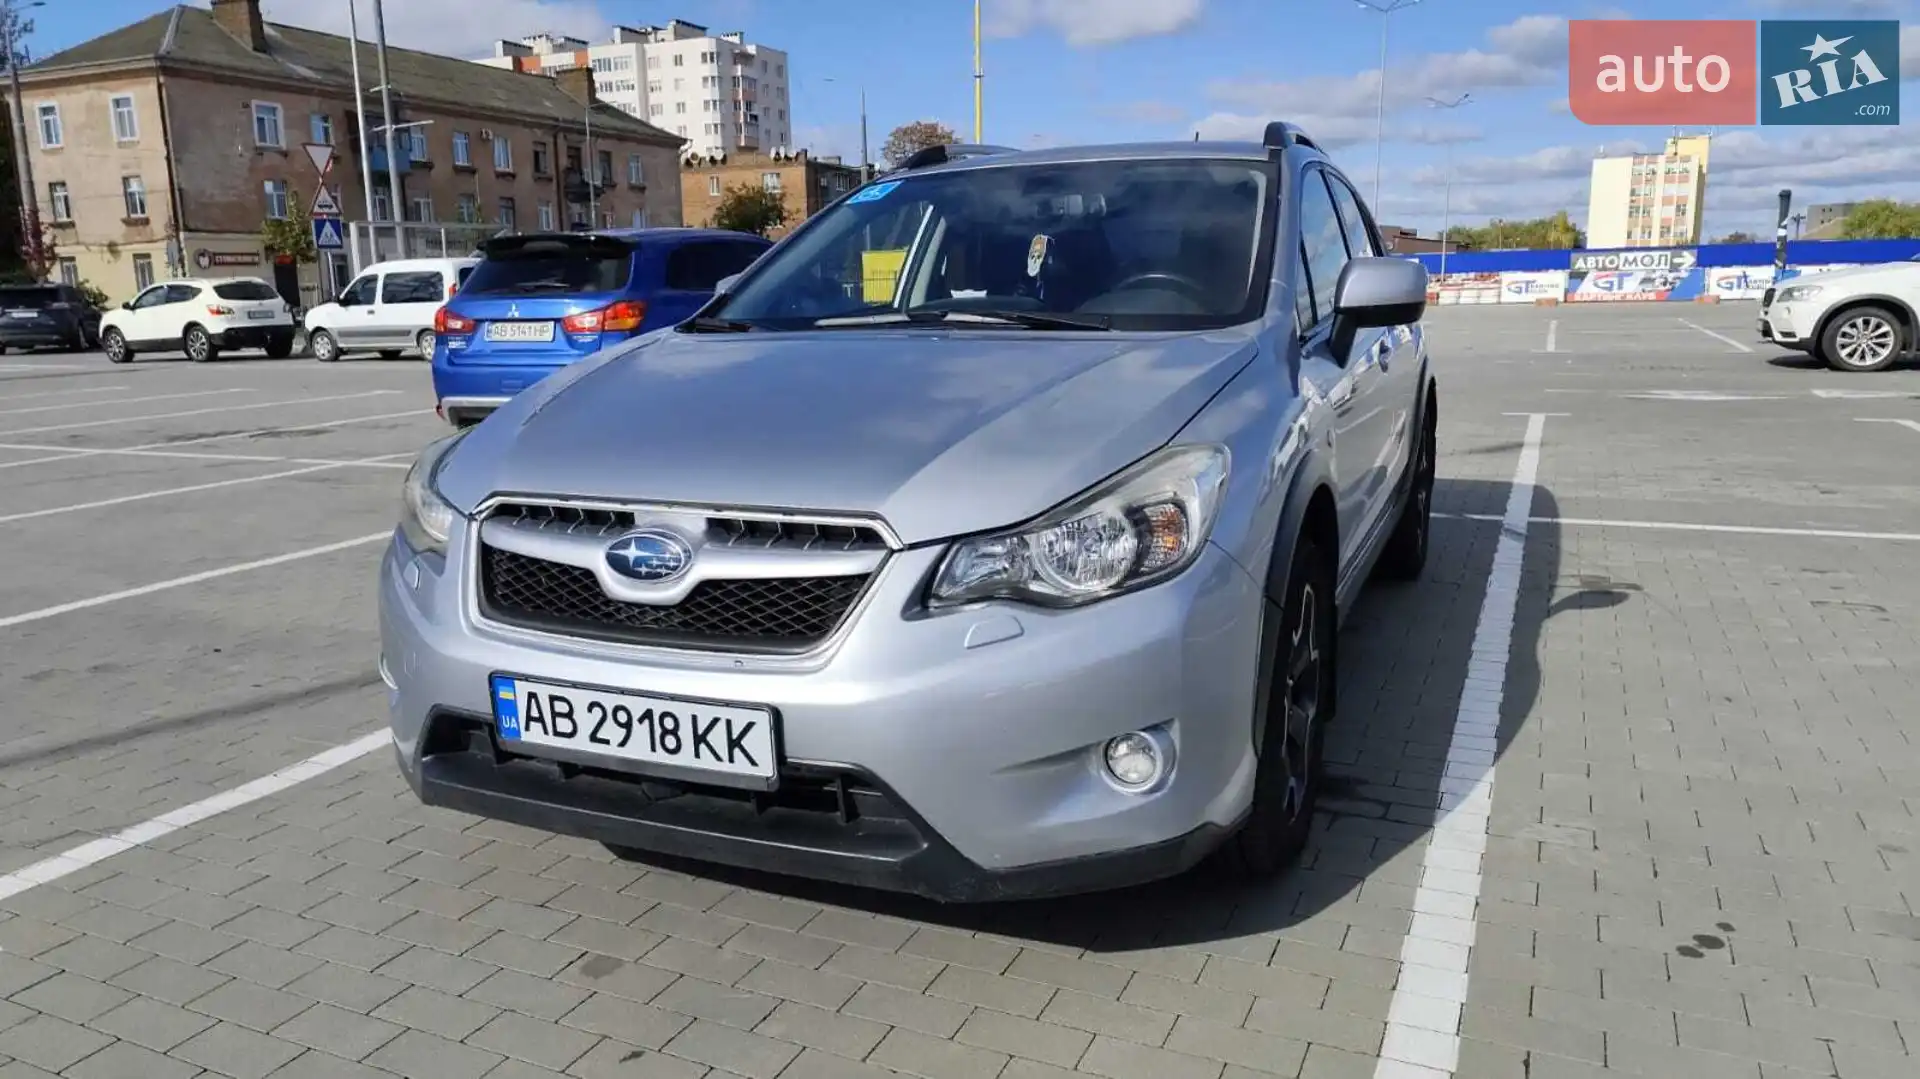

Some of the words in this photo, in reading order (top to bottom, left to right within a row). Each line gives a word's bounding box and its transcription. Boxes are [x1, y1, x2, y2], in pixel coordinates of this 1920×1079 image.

[1507, 279, 1537, 295] GT
[1593, 271, 1634, 292] GT
[510, 324, 532, 337] 5141
[501, 715, 519, 730] UA
[524, 691, 578, 739] AB
[587, 701, 682, 755] 2918
[691, 714, 759, 767] KK
